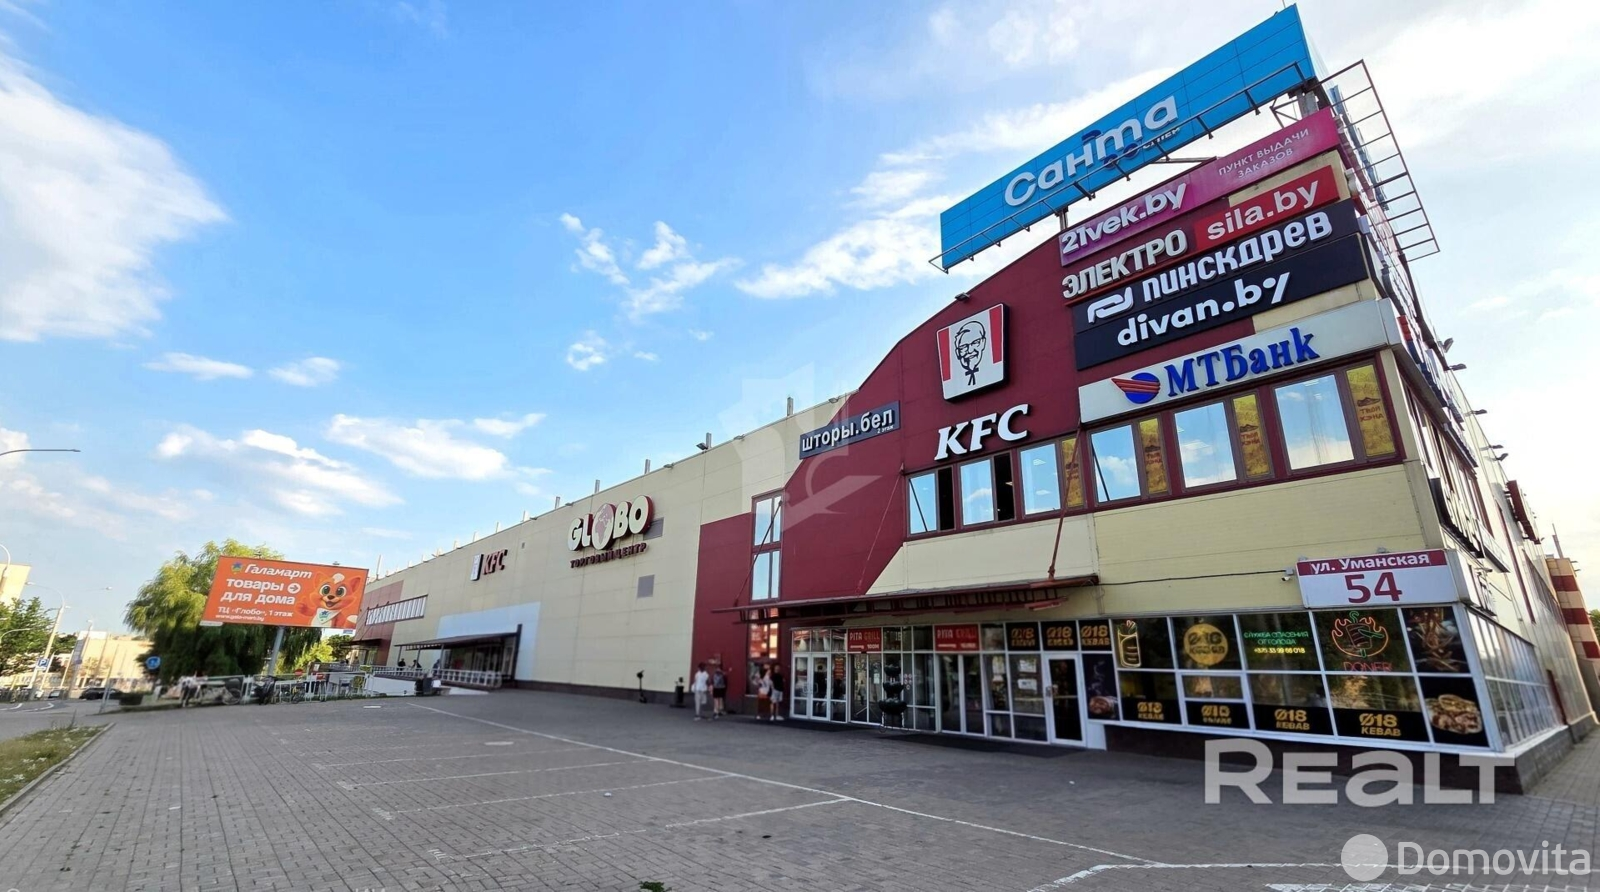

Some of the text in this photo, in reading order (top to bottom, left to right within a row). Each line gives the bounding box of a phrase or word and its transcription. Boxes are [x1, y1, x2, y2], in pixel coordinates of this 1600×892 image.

[1004, 96, 1179, 207] Санта
[1219, 129, 1310, 176] ПУНКТ ВЫДАЧИ
[1238, 148, 1293, 179] ЗАКАЗОВ
[1061, 183, 1187, 254] 21vek.by
[1207, 180, 1319, 240] sila.by
[1062, 228, 1188, 299] ЭЛЕКТРО
[1117, 271, 1290, 347] divan.by
[1164, 327, 1321, 397] МТБанк
[802, 408, 893, 452] шторы.бел
[934, 403, 1029, 461] KFC
[567, 495, 653, 551] GLOBO
[483, 549, 508, 575] KFC
[615, 542, 647, 559] ЦЕНТР
[1311, 553, 1430, 575] ул. Уманская
[226, 578, 284, 593] товары
[244, 563, 313, 580] Галамарт
[1344, 571, 1403, 604] 54
[220, 591, 296, 606] для дома
[849, 631, 863, 641] PITA
[1276, 721, 1310, 731] KEBAB
[1361, 726, 1401, 737] KEBAB
